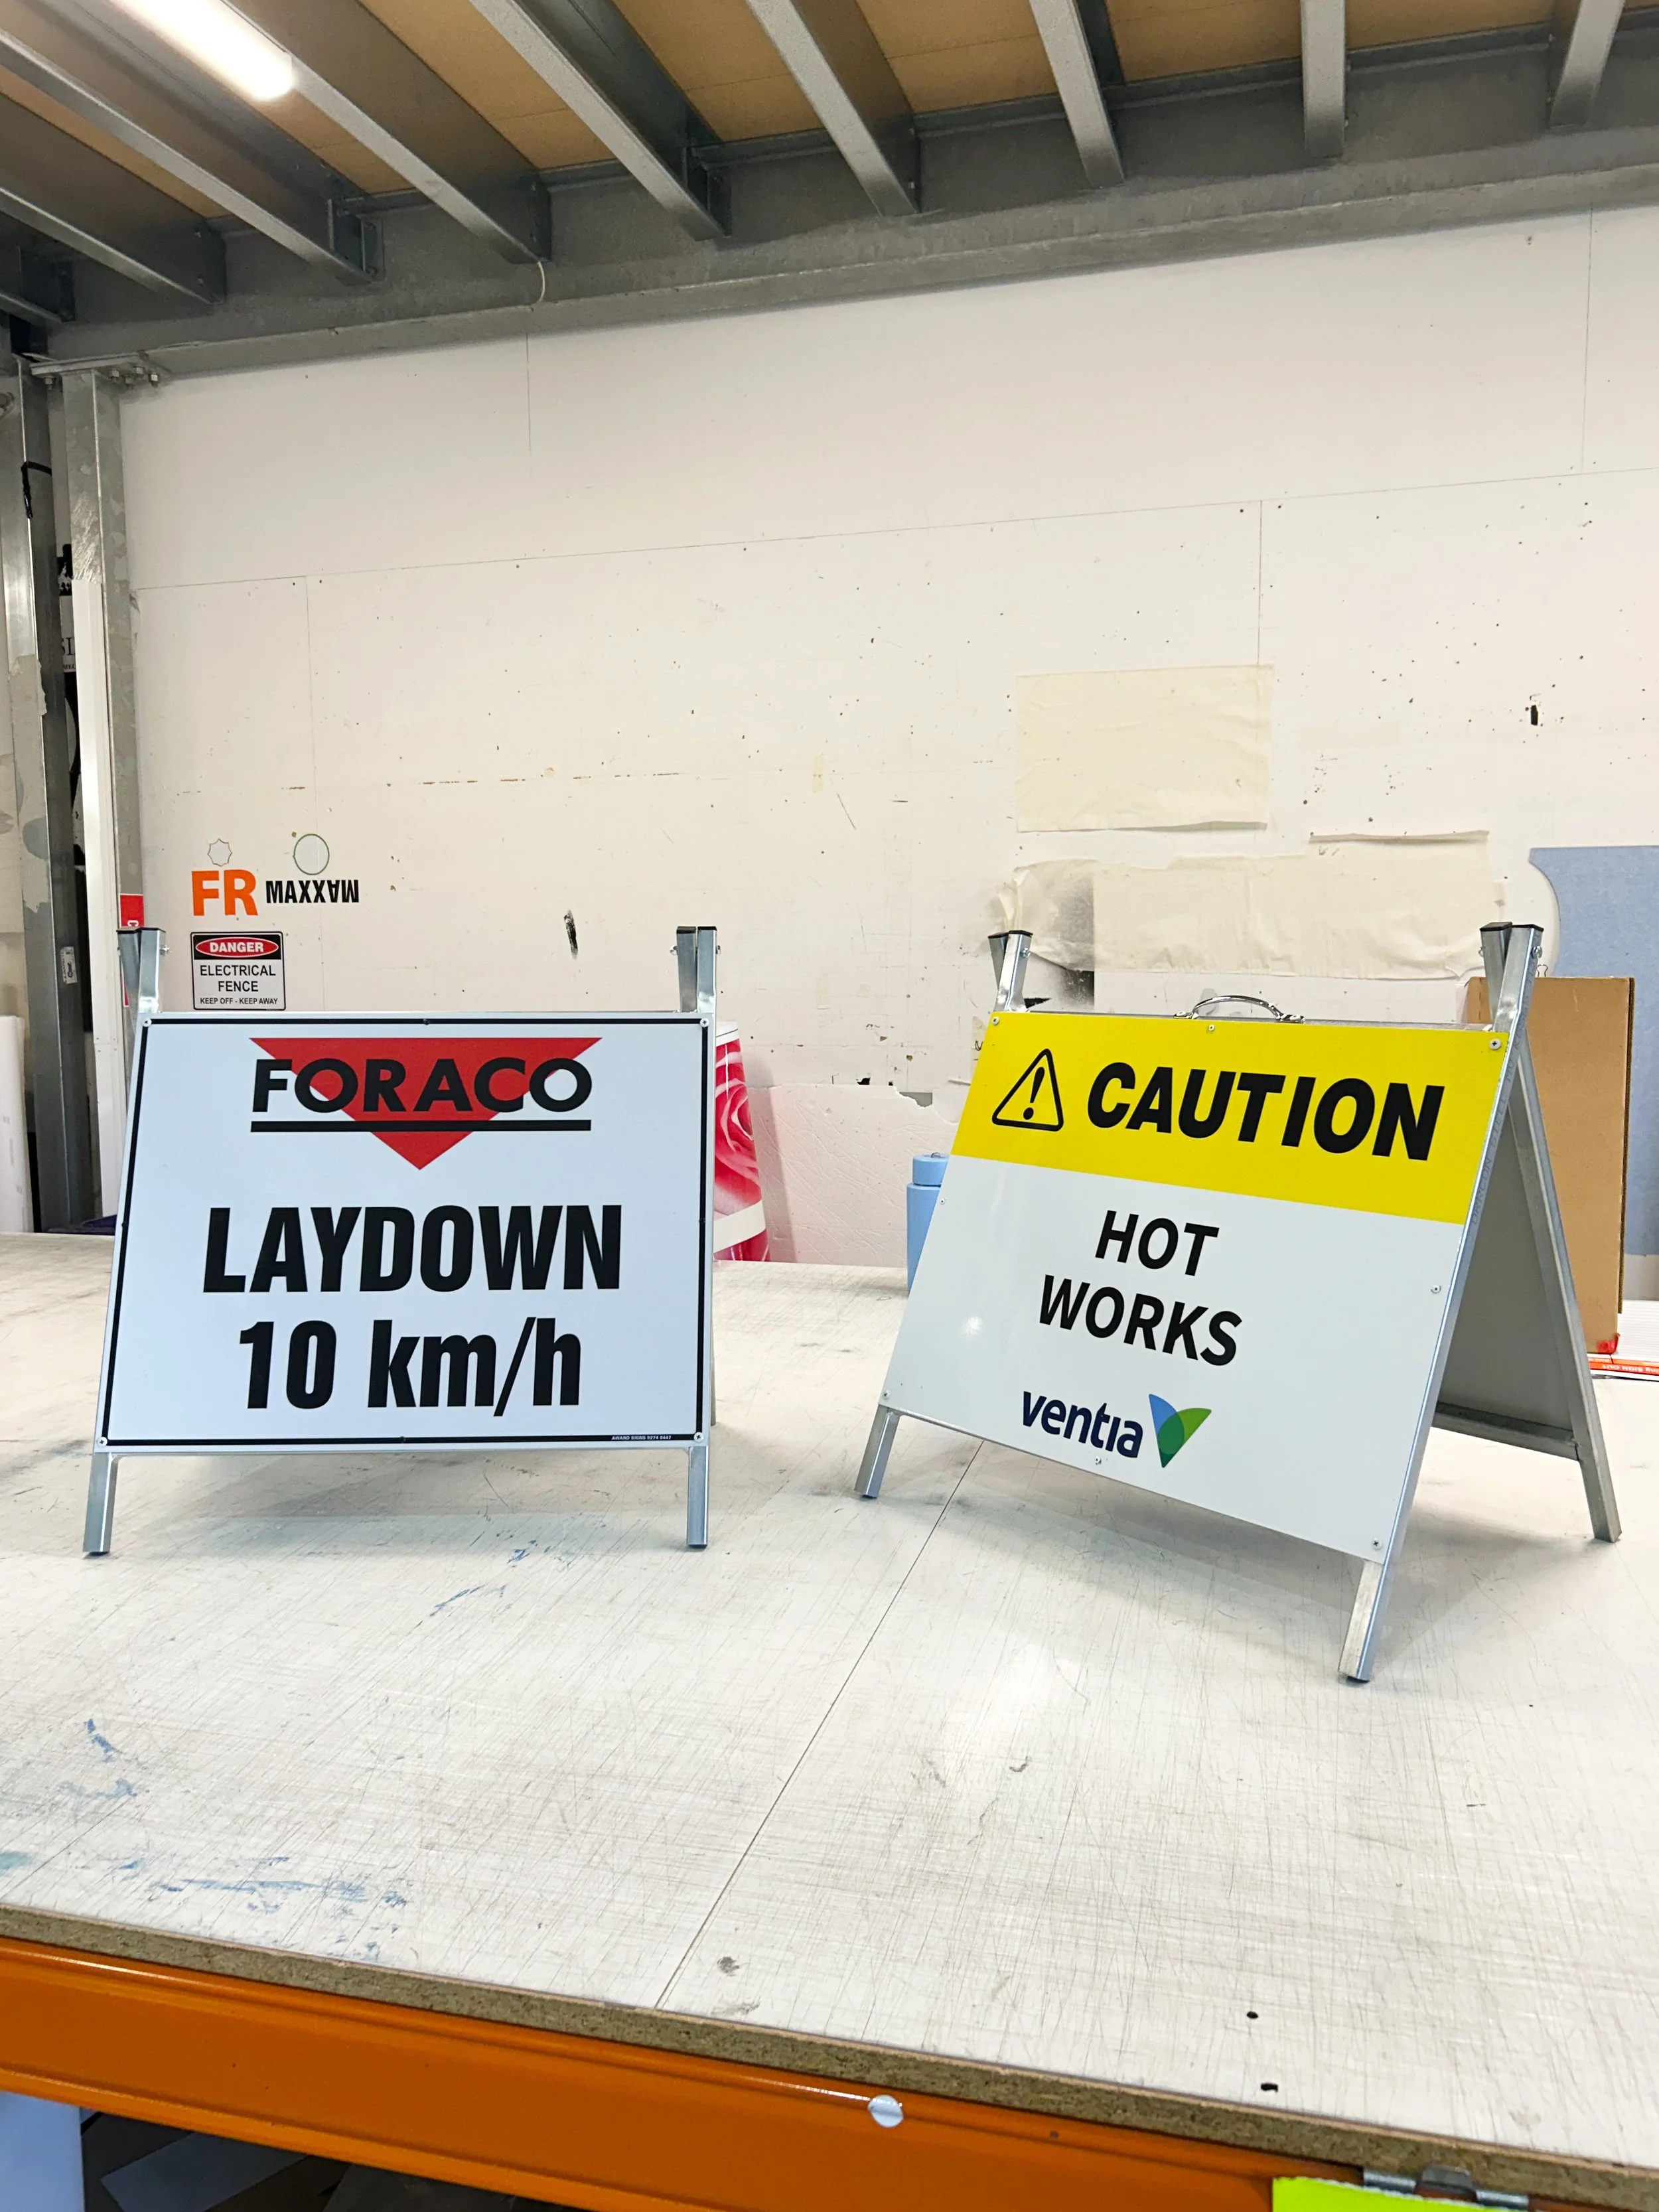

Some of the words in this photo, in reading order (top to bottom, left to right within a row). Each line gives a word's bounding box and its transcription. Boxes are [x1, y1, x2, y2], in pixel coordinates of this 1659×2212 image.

[192, 869, 258, 917] FR
[200, 965, 276, 976] ELECTRICAL
[210, 942, 264, 952] DANGER
[218, 981, 259, 992] FENCE
[252, 1057, 592, 1114] FORACO
[1087, 1062, 1445, 1161] CAUTION
[203, 1205, 622, 1293] LAYDOWN
[1095, 1210, 1220, 1276] HOT
[1039, 1274, 1243, 1366] WORKS
[239, 1320, 337, 1410] 10
[367, 1317, 581, 1417] km/h
[1023, 1391, 1143, 1458] ventia
